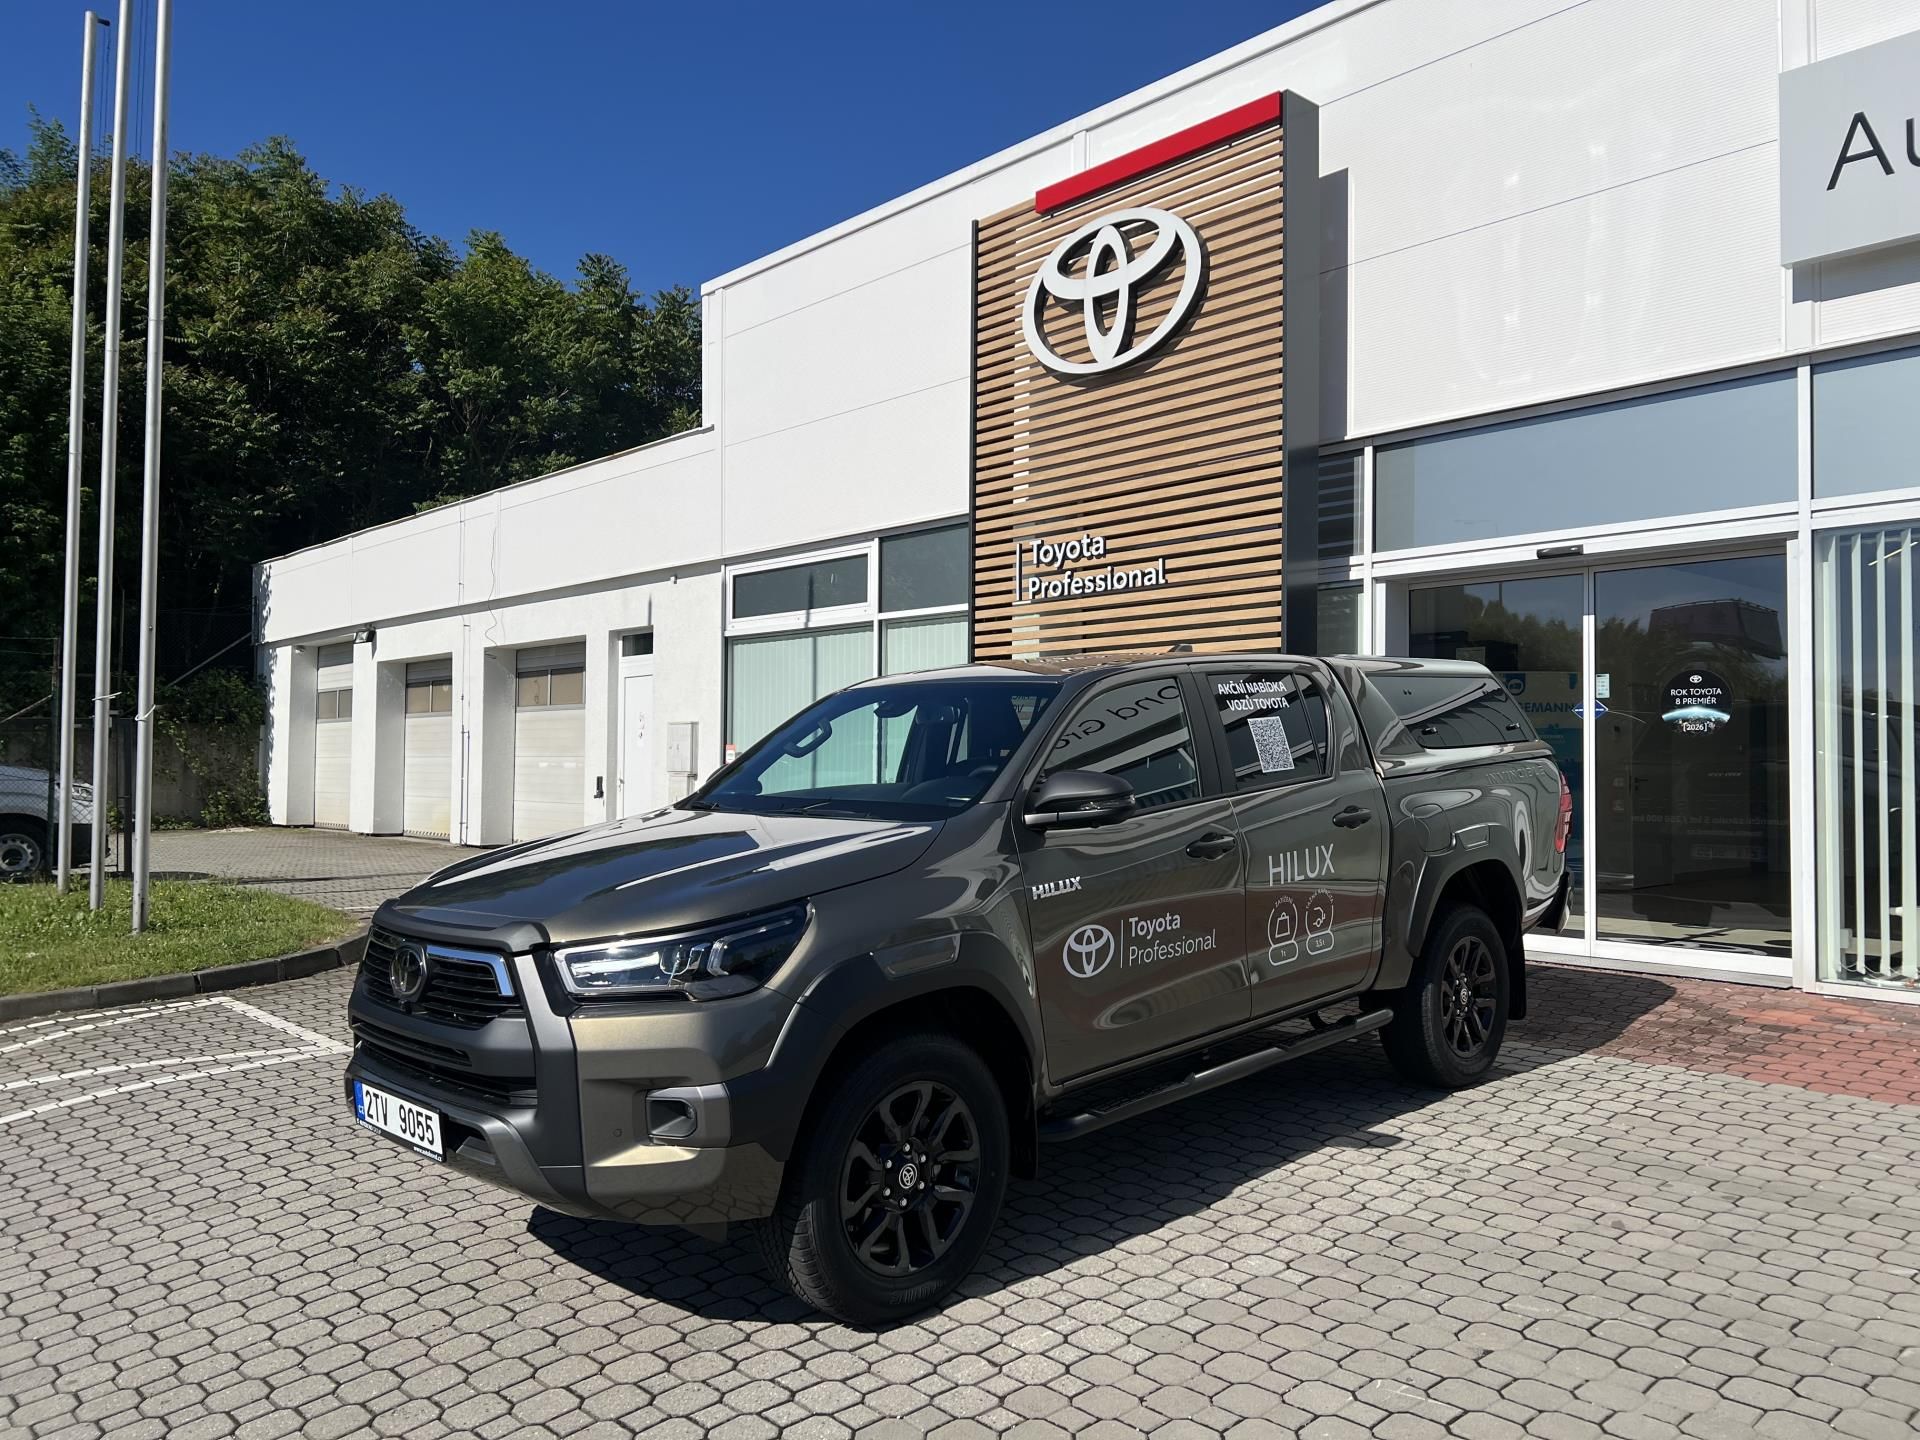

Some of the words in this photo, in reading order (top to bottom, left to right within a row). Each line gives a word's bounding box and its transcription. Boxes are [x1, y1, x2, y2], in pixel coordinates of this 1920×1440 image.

[1029, 533, 1105, 569] Toyota
[1028, 558, 1167, 600] Professional
[1217, 679, 1247, 695] AKČNÍ
[1246, 678, 1288, 694] NABÍDKA
[1670, 688, 1688, 696] ROK
[1689, 687, 1722, 696] TOYOTA
[1682, 696, 1717, 705] PREMIÉR
[1226, 695, 1255, 711] VOZŮ
[1253, 696, 1290, 710] TOYOTA
[1268, 843, 1335, 887] HILUX
[1031, 876, 1082, 900] HILUX
[1128, 911, 1181, 941] Toyota
[1128, 928, 1217, 967] Professional
[365, 1089, 388, 1126] 2TV
[398, 1103, 435, 1146] 9055
